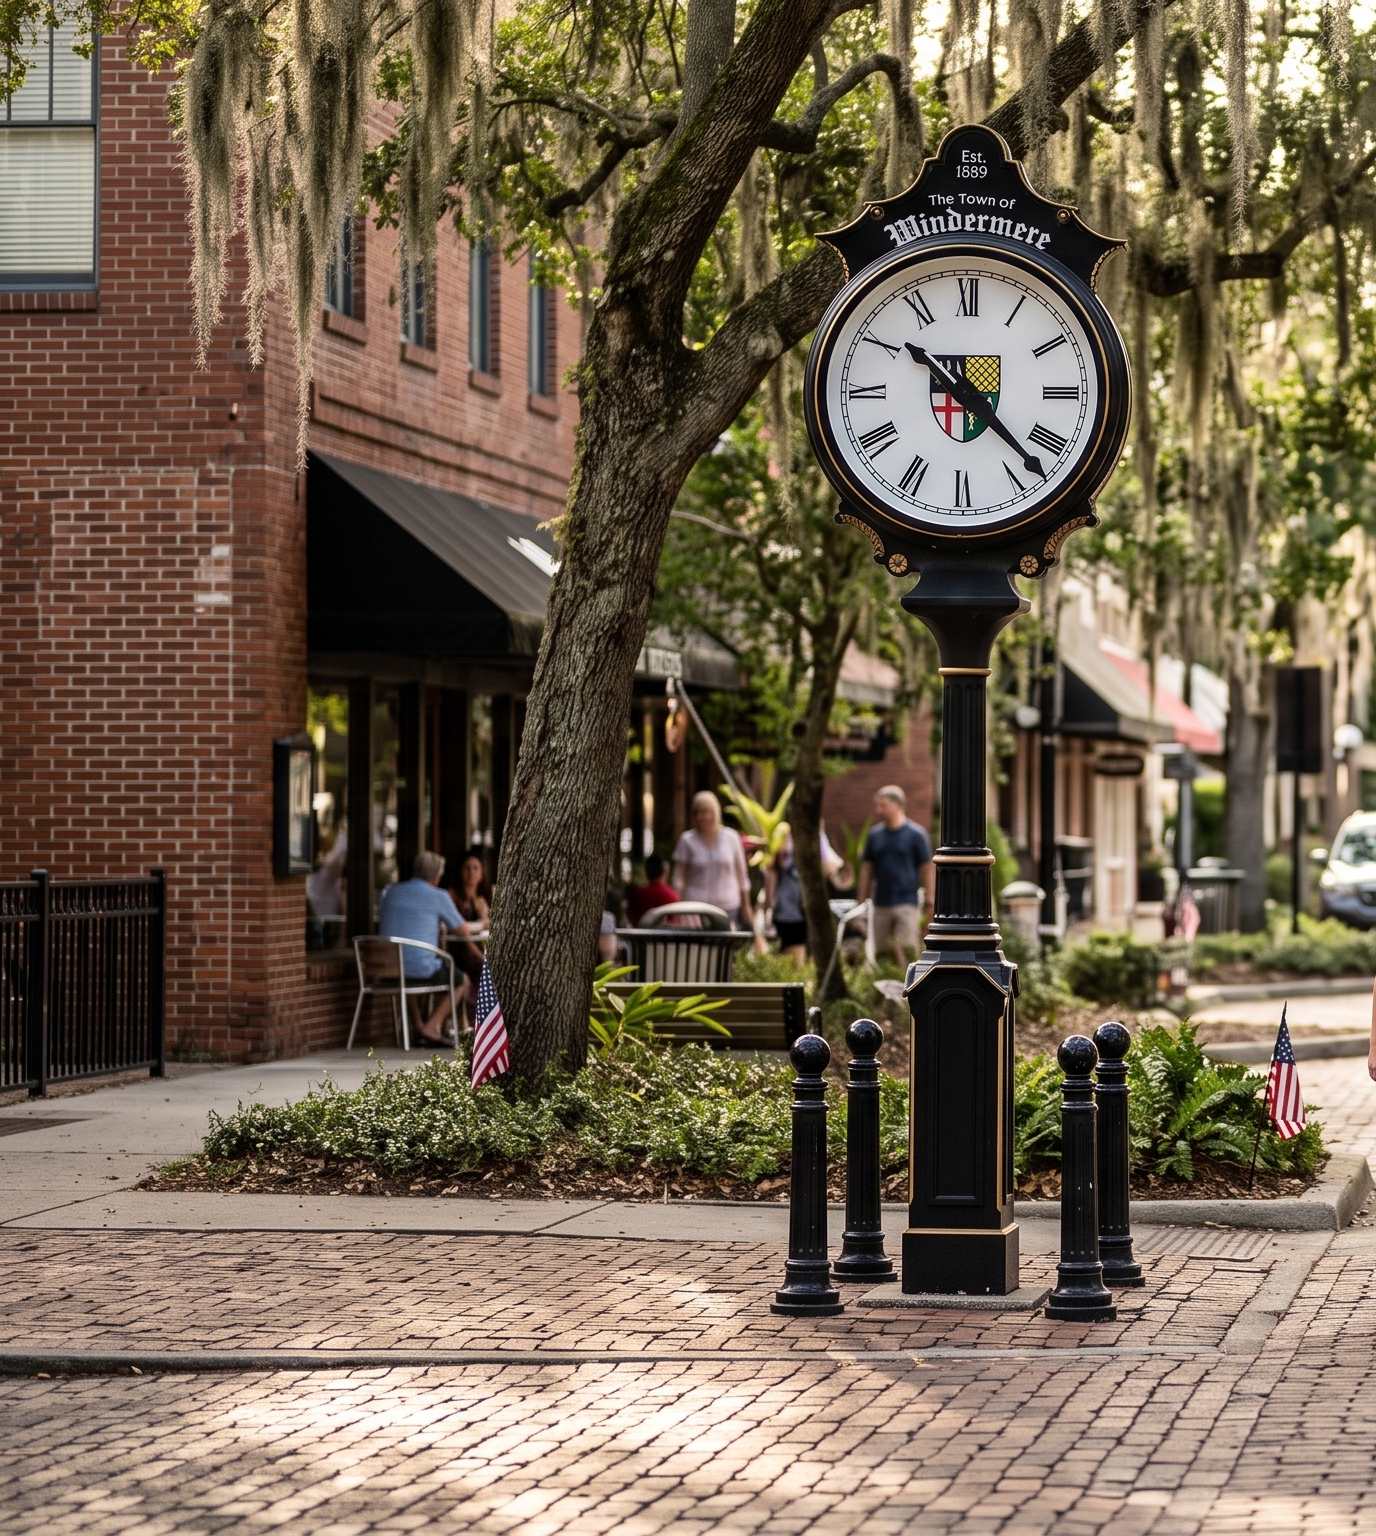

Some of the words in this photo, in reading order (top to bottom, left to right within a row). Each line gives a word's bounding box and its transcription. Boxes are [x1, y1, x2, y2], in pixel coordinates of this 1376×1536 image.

[962, 150, 987, 164] Est.
[956, 165, 988, 179] 1889
[928, 194, 955, 206] The
[958, 193, 996, 207] Town
[999, 199, 1016, 210] of
[883, 207, 1052, 250] Windermere
[955, 278, 980, 317] XII
